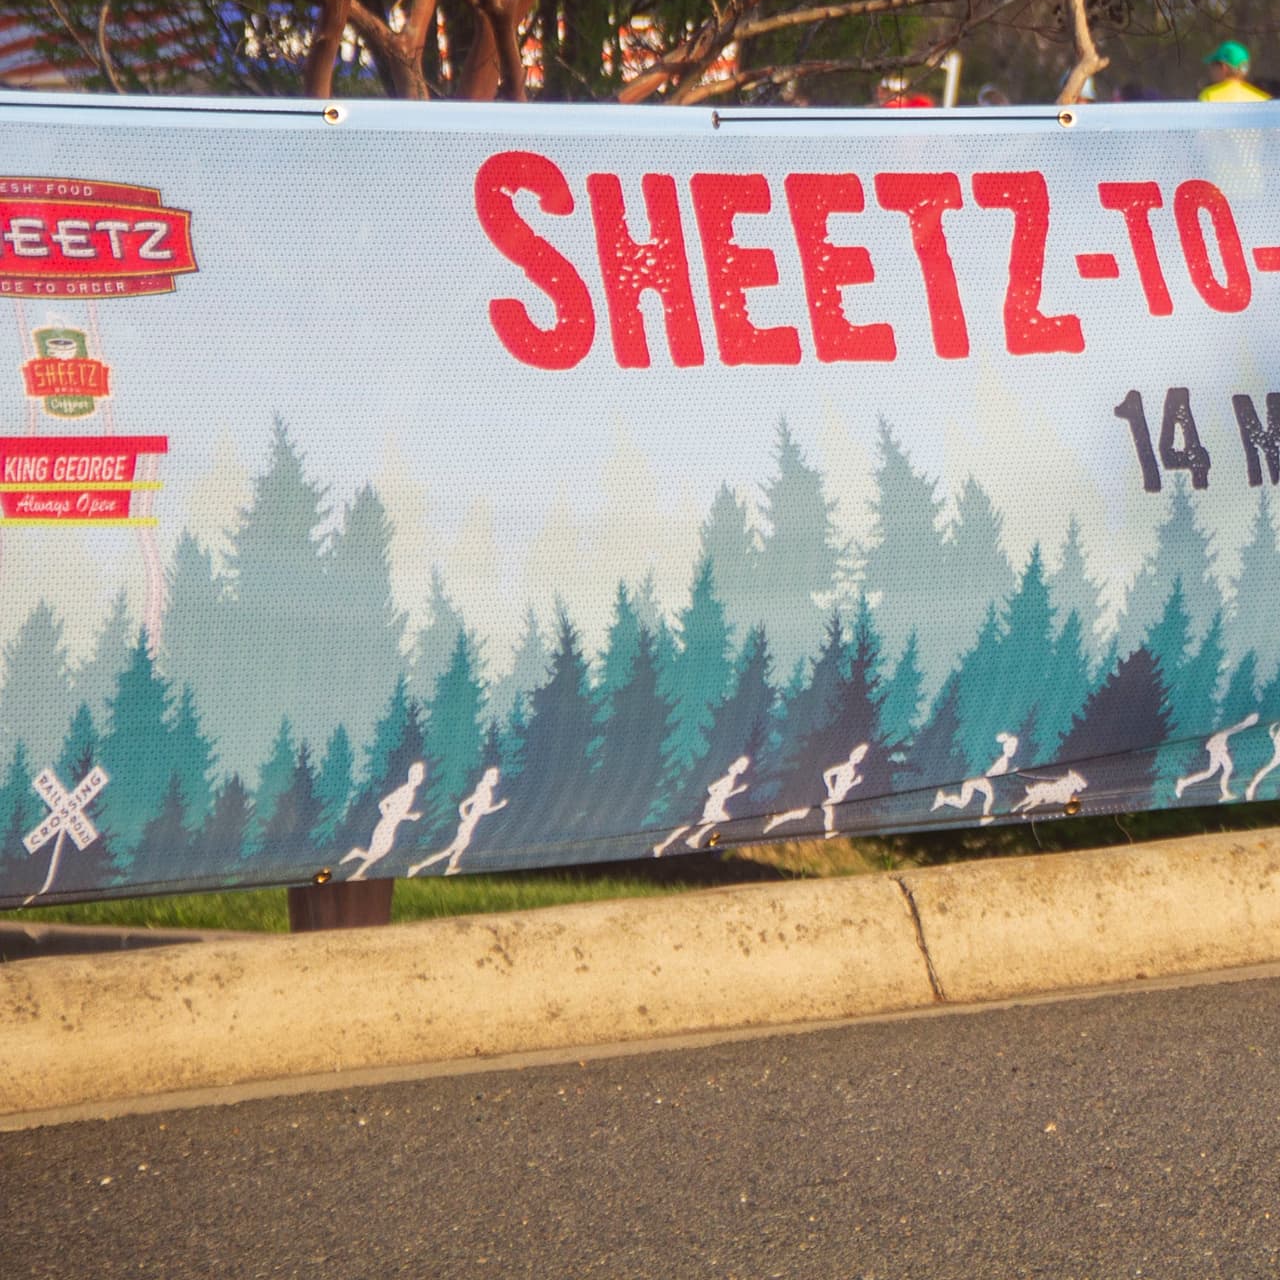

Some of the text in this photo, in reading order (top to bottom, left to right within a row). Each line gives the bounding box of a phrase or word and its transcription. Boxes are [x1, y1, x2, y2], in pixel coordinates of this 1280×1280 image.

[0, 182, 93, 197] ESH FOOD
[0, 218, 172, 260] EETZ
[0, 280, 126, 295] DE TO ORDER
[34, 362, 97, 388] SHEETZ
[1115, 387, 1210, 493] 14
[4, 455, 128, 482] KING GEORGE
[16, 492, 117, 517] Always Open
